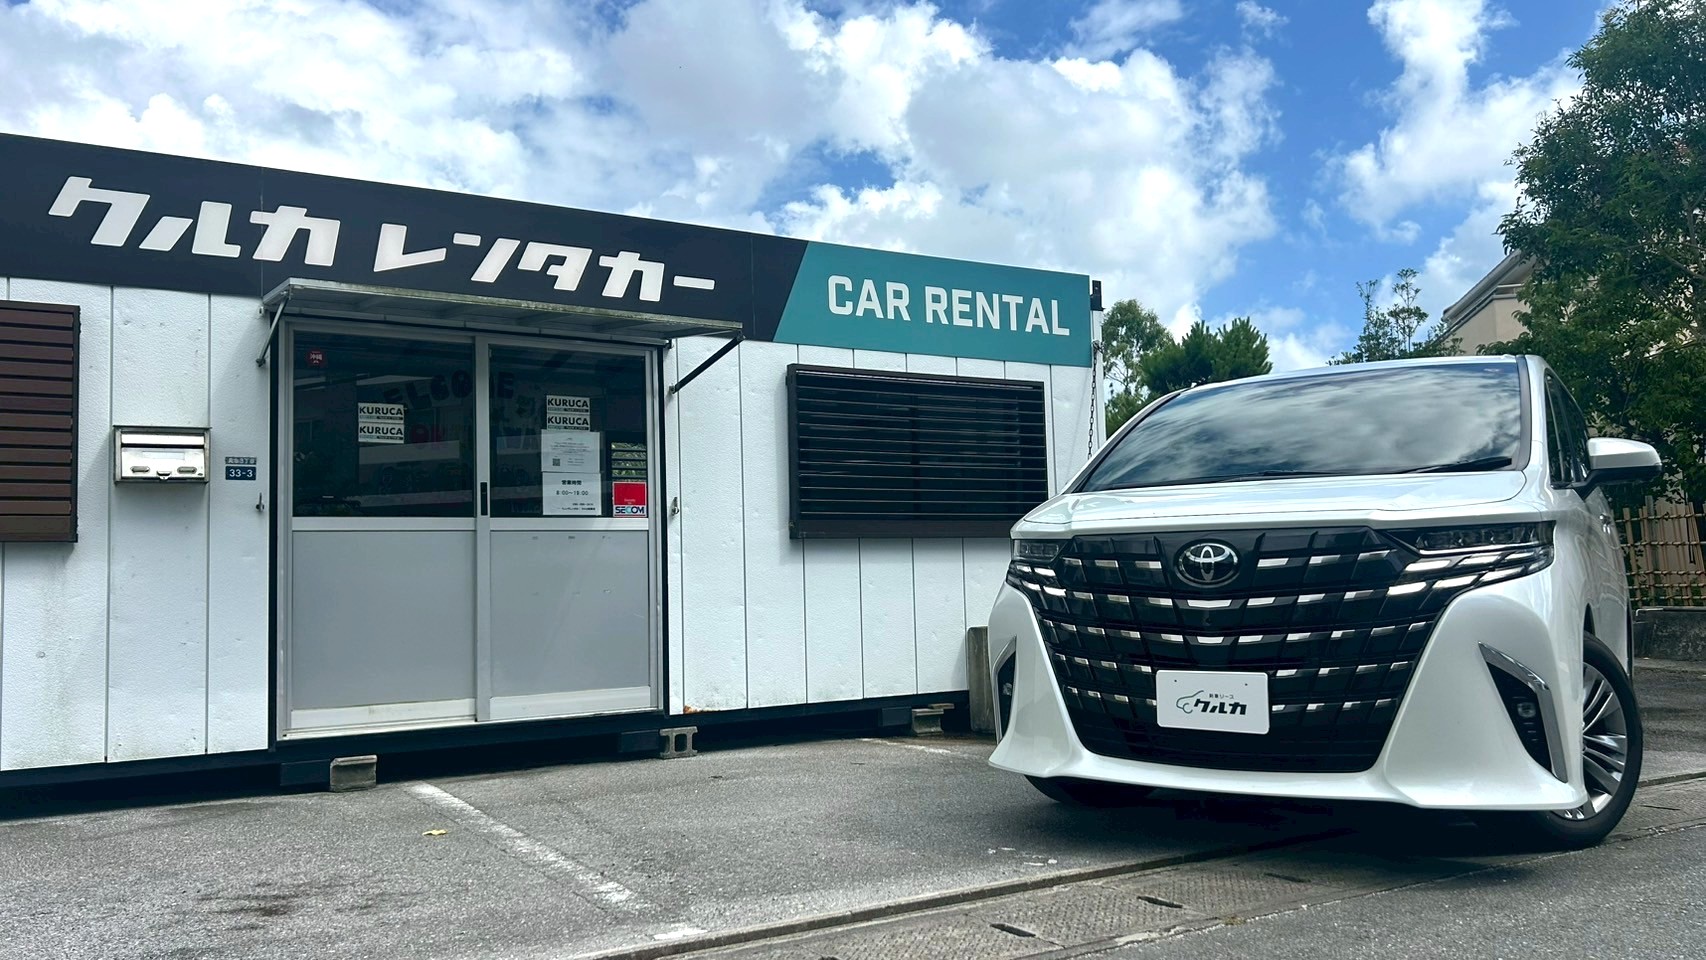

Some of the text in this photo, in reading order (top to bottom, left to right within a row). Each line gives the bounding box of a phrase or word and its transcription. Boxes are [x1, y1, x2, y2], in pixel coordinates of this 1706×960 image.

[48, 176, 715, 303] クルカ レンタカー
[828, 275, 1070, 336] CAR RENTAL
[547, 398, 588, 408] KURUCA
[359, 406, 403, 416] KURUCA
[547, 416, 588, 426] KURUCA
[359, 426, 403, 436] KURUCA
[229, 468, 253, 478] 33-3
[615, 506, 645, 514] SECOM
[1194, 698, 1247, 715] クルカ
